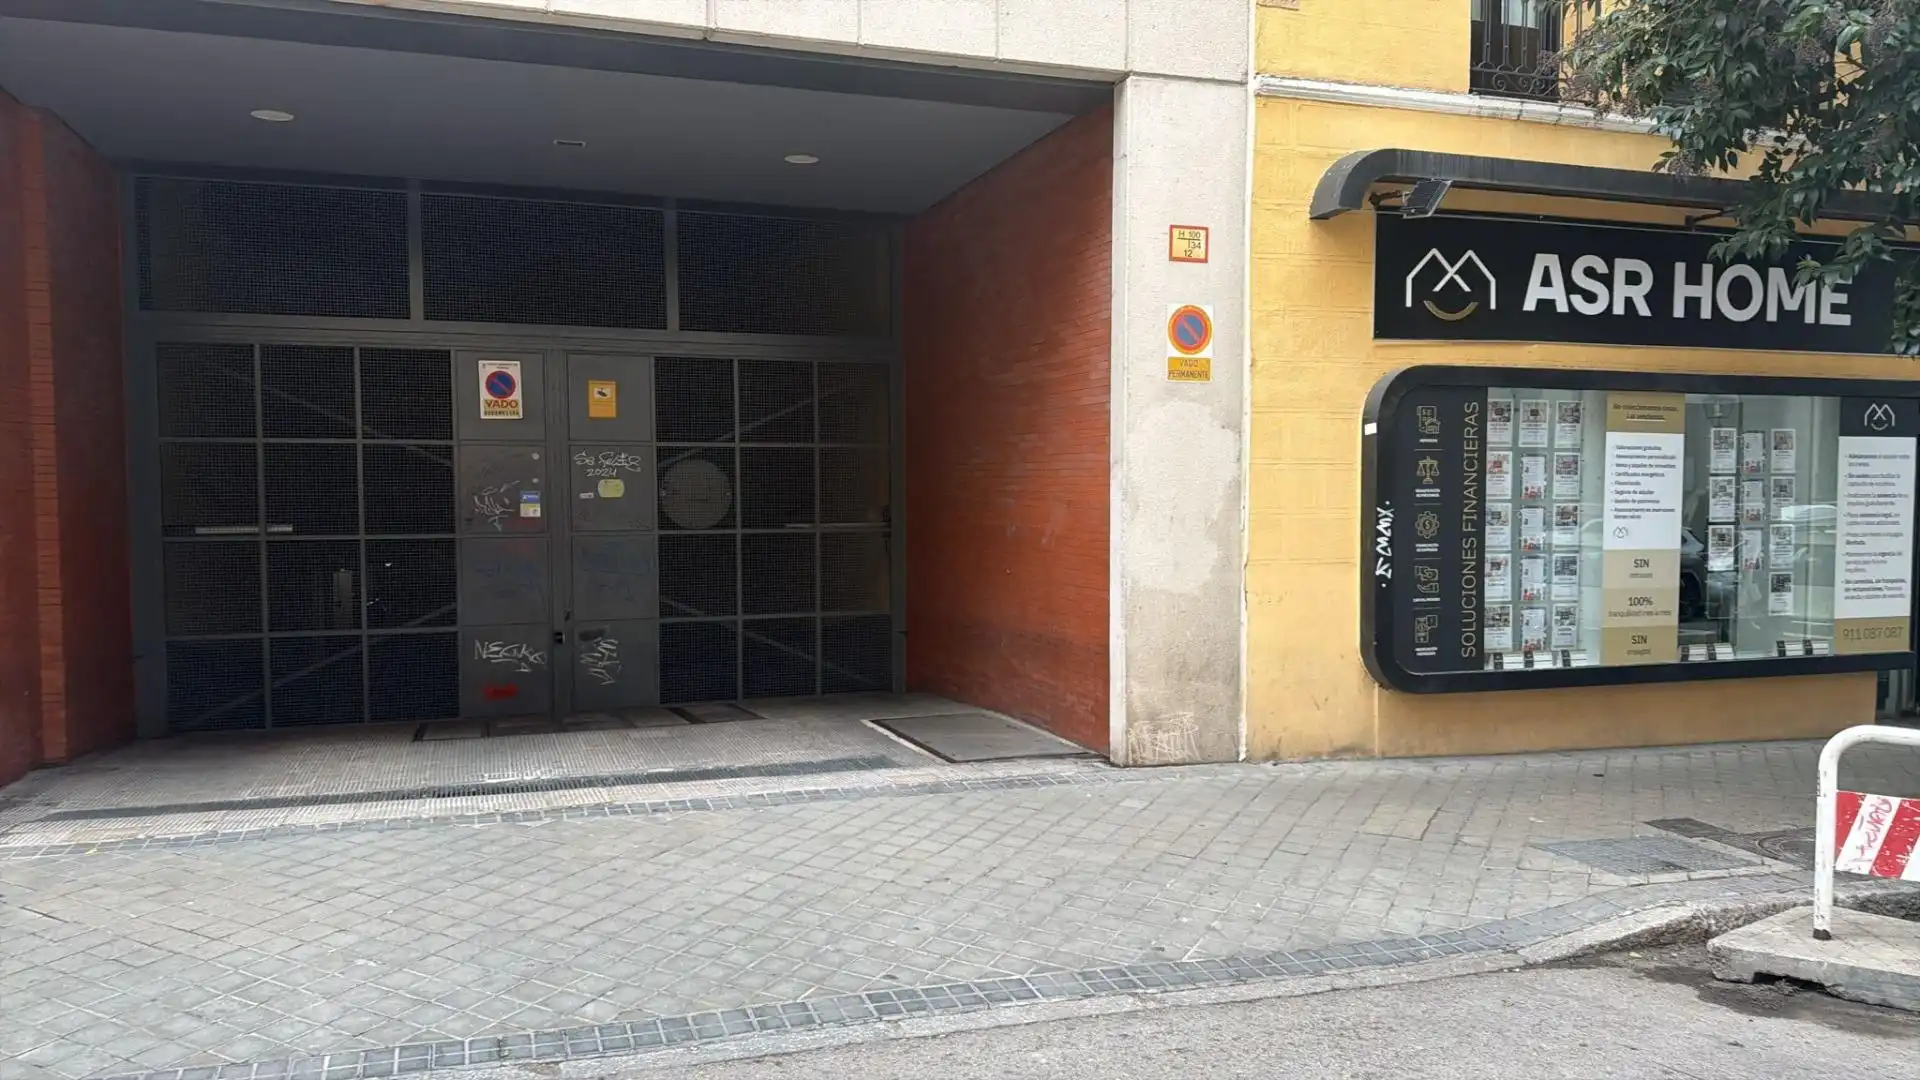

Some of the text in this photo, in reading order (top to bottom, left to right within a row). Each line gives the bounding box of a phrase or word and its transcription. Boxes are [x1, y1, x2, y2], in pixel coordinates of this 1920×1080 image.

[1189, 231, 1201, 239] 100
[1184, 249, 1193, 258] 12
[1522, 253, 1852, 326] ASR HOME
[485, 399, 519, 409] VADO
[1461, 401, 1480, 658] SOLUCIONES FINANCIERAS
[1633, 558, 1649, 568] SIN
[1628, 597, 1653, 606] 100%
[1631, 635, 1647, 645] SIN
